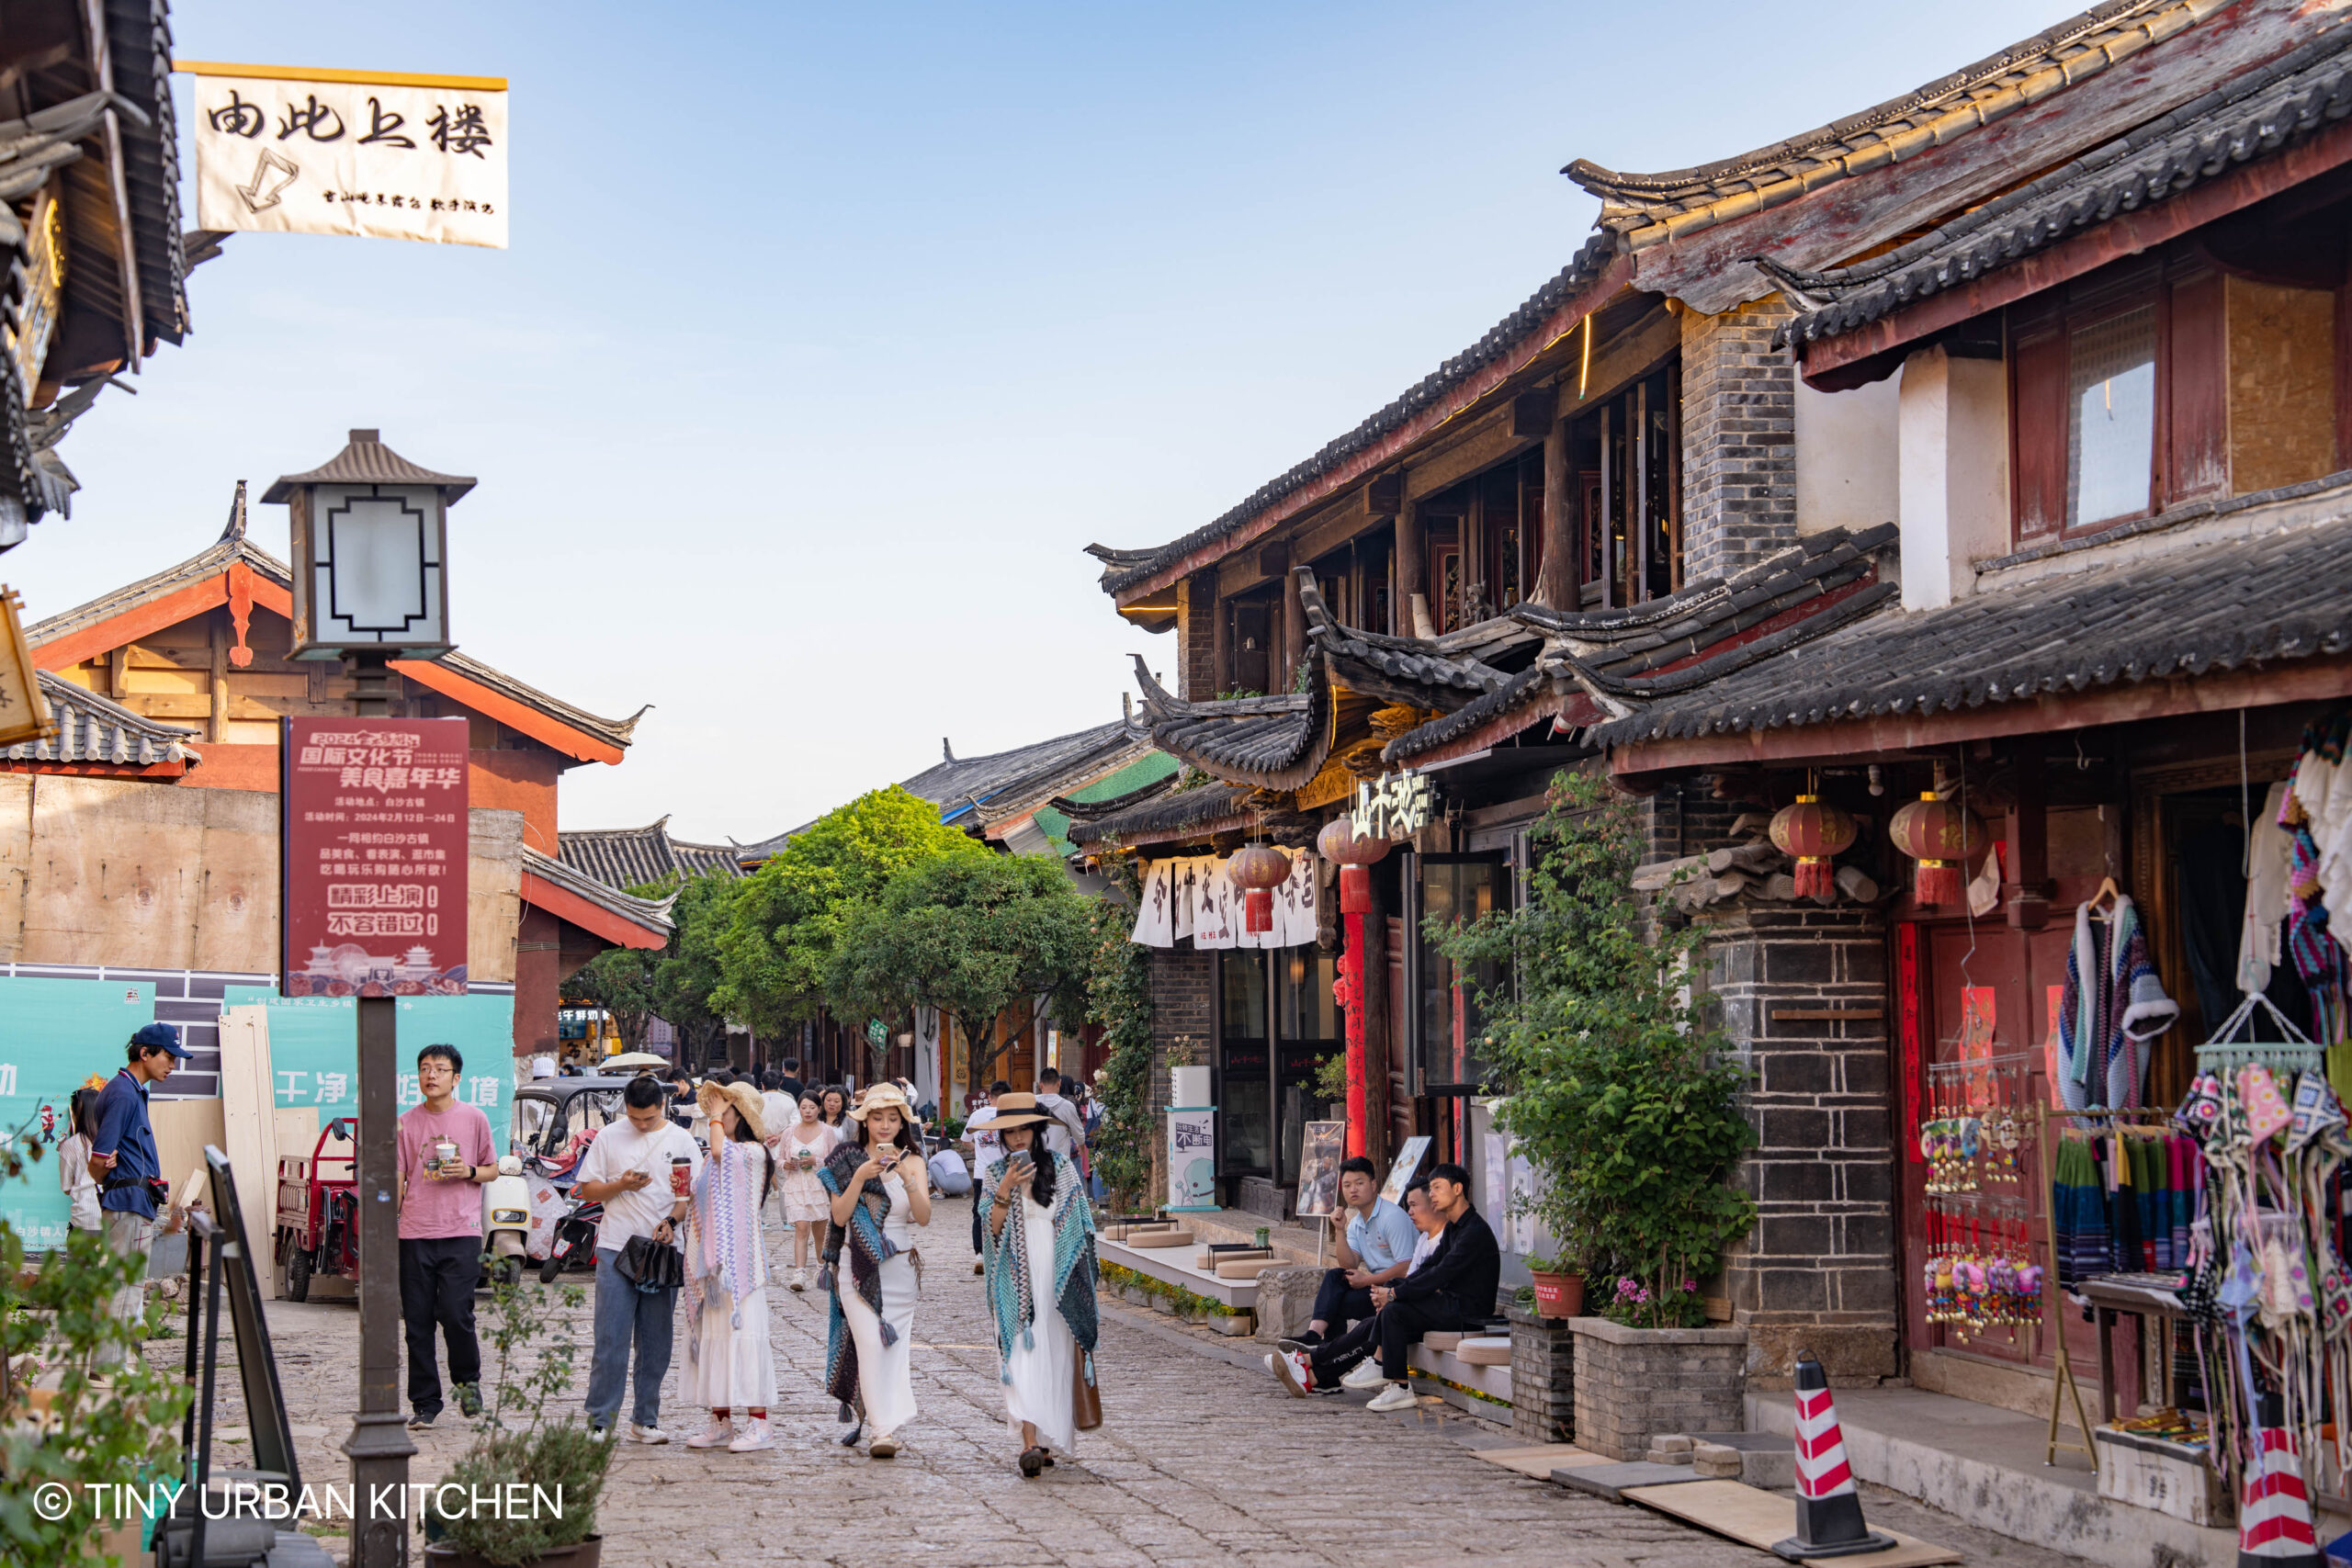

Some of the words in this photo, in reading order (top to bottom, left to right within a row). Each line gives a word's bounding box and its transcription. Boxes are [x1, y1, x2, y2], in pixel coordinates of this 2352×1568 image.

[208, 89, 492, 159] 由此上楼
[300, 747, 413, 765] 国际文化节
[340, 766, 461, 794] 美食嘉年华
[327, 885, 438, 908] 精彩上演！
[327, 913, 438, 935] 不容错过！
[276, 1070, 499, 1107] 干净好境
[1177, 1132, 1212, 1146] 不断电
[16, 1225, 70, 1237] 白沙镇人
